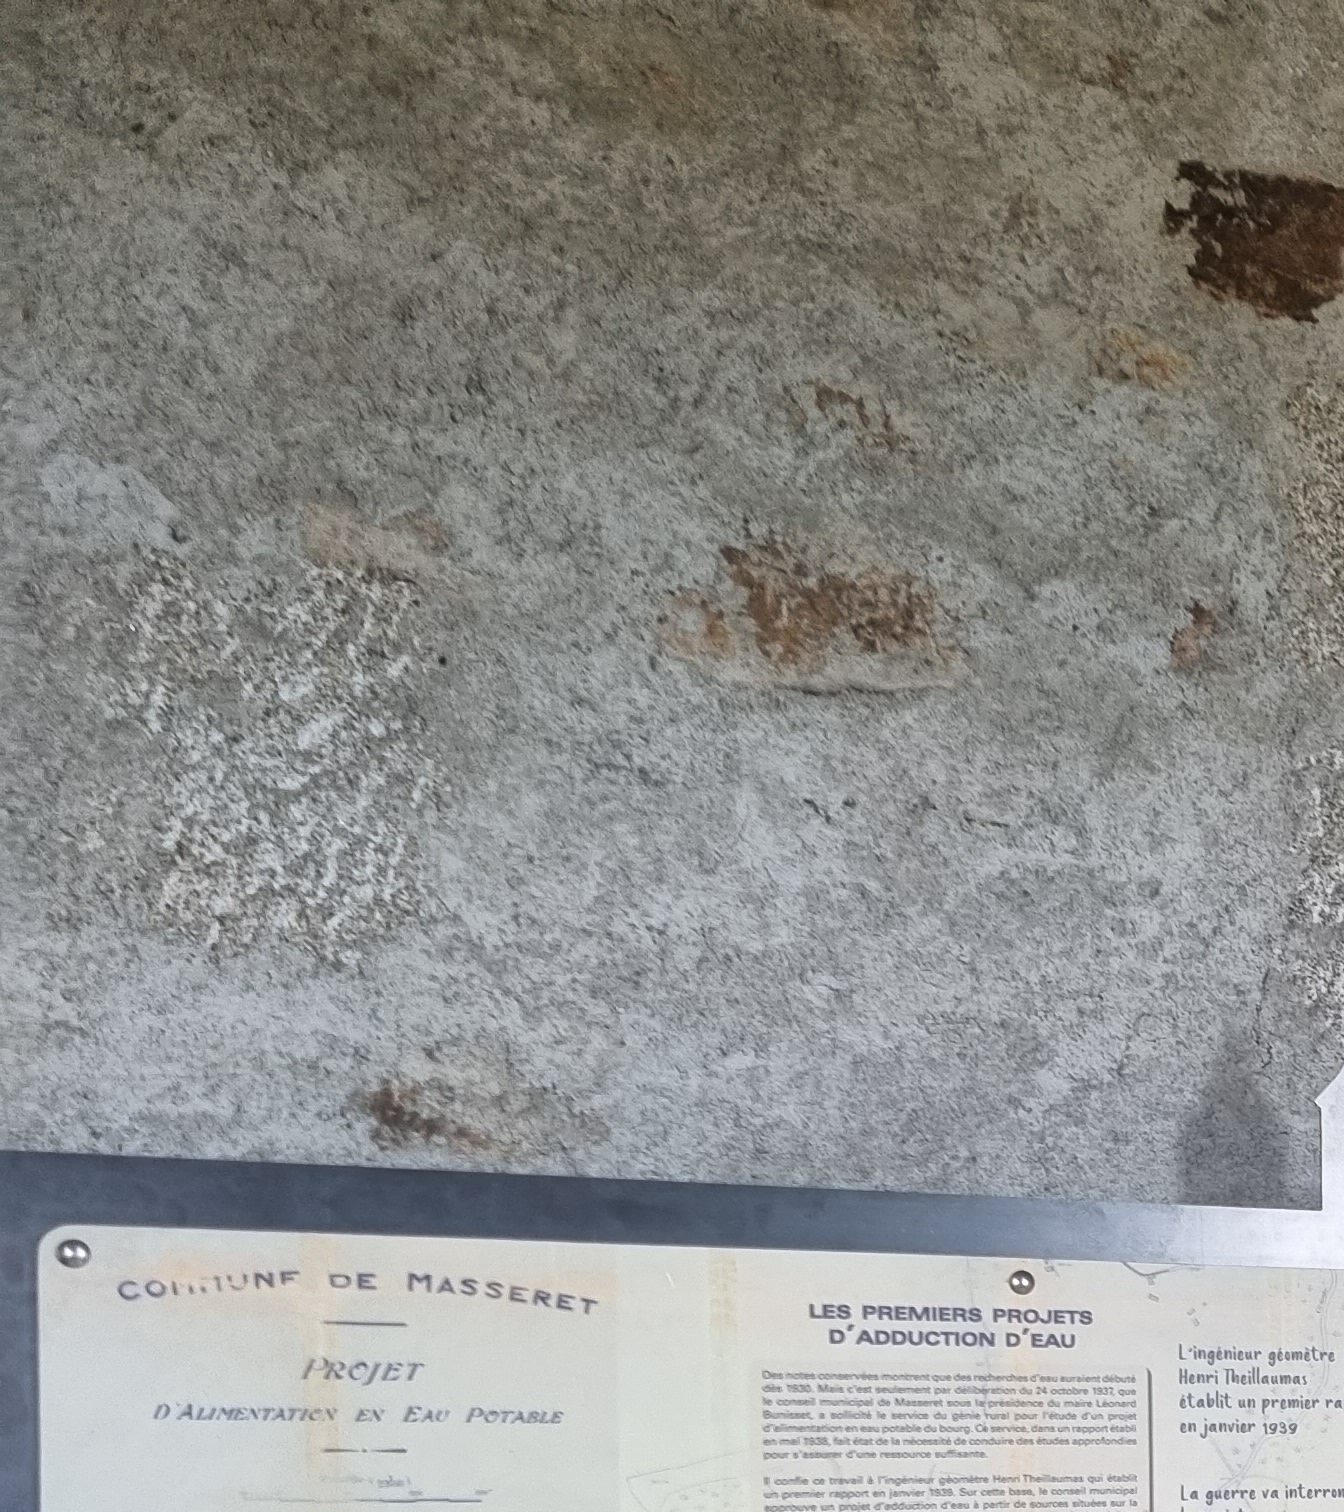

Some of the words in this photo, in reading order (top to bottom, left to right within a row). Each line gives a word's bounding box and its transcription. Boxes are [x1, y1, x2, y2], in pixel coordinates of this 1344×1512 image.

[329, 1273, 377, 1290] DE
[407, 1273, 598, 1315] MASSERET
[809, 1303, 851, 1319] LES
[862, 1305, 982, 1322] PREMIERS
[992, 1308, 1092, 1325] PROJETS
[828, 1324, 995, 1347] D'ADDUCTION
[1005, 1327, 1075, 1348] D'EAU
[1178, 1343, 1262, 1365] L'ingénieur
[1268, 1346, 1335, 1366] géomètre
[301, 1357, 425, 1386] PROJET
[1179, 1368, 1218, 1384] Henri
[1223, 1367, 1307, 1385] Theillaumas
[153, 1403, 338, 1421] D'ALIMENTATION
[354, 1408, 385, 1422] EN
[402, 1405, 450, 1422] EAU
[465, 1407, 564, 1423] POTABLE
[1179, 1390, 1232, 1408] établit
[1238, 1398, 1255, 1408] un
[1261, 1395, 1319, 1414] premier
[1179, 1422, 1196, 1433] en
[1199, 1418, 1255, 1439] janvier
[1262, 1421, 1297, 1434] 1939
[1180, 1484, 1198, 1501] La
[1205, 1489, 1256, 1506] guerre
[1262, 1488, 1279, 1499] va
